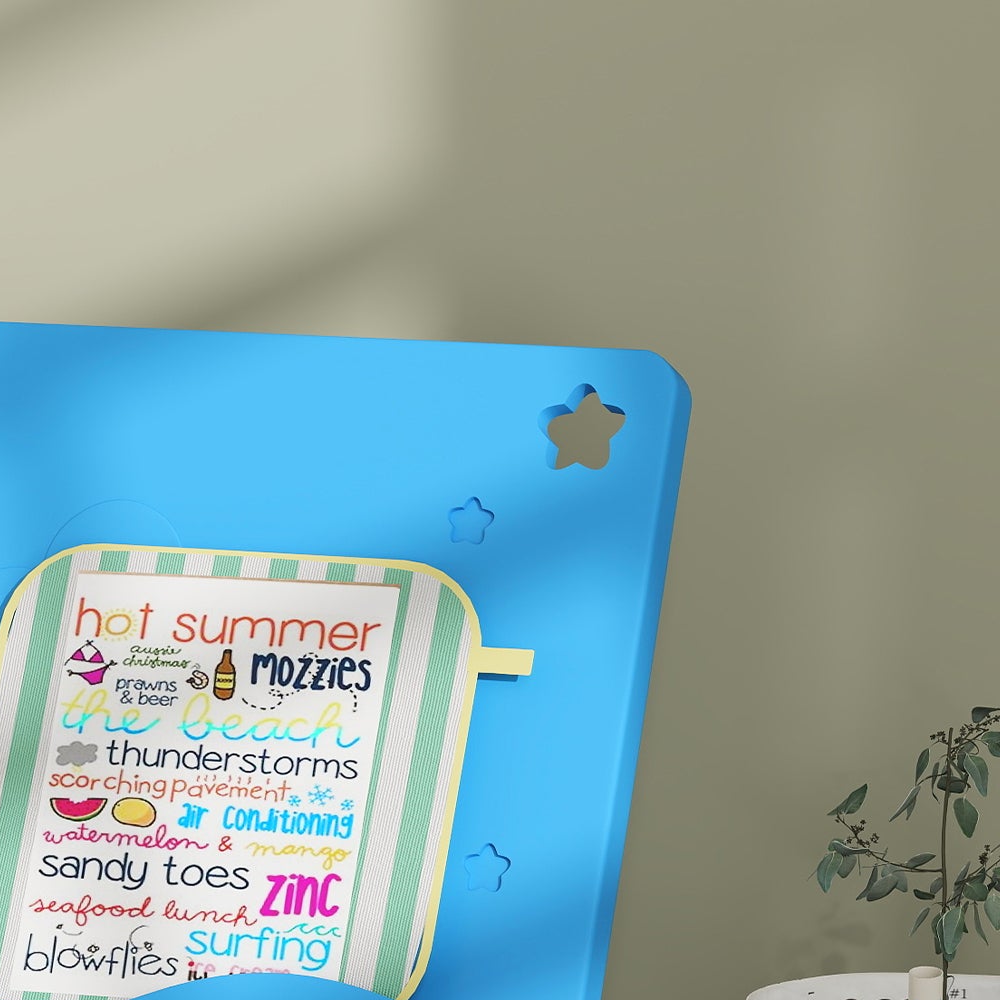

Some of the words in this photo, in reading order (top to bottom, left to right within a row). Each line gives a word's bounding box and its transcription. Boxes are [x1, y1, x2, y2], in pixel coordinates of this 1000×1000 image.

[74, 597, 154, 640] hot
[172, 612, 382, 652] summer
[123, 654, 191, 668] christmas
[130, 645, 182, 655] aussie
[115, 677, 177, 692] prawns
[119, 690, 133, 704] &
[138, 691, 179, 706] beer
[60, 688, 161, 735] the
[177, 691, 361, 749] beach
[106, 739, 359, 780] thunderstorms
[49, 769, 167, 798] scorching
[170, 777, 292, 803] pavement
[177, 802, 209, 829] air
[43, 823, 210, 851] watermelon
[218, 835, 233, 852] &
[245, 842, 352, 871] mango
[38, 852, 148, 890] sandy
[163, 856, 250, 889] toes
[29, 895, 156, 926] seafood
[163, 900, 258, 926] lunch
[24, 933, 178, 978] blowflies
[184, 926, 331, 971] surfing
